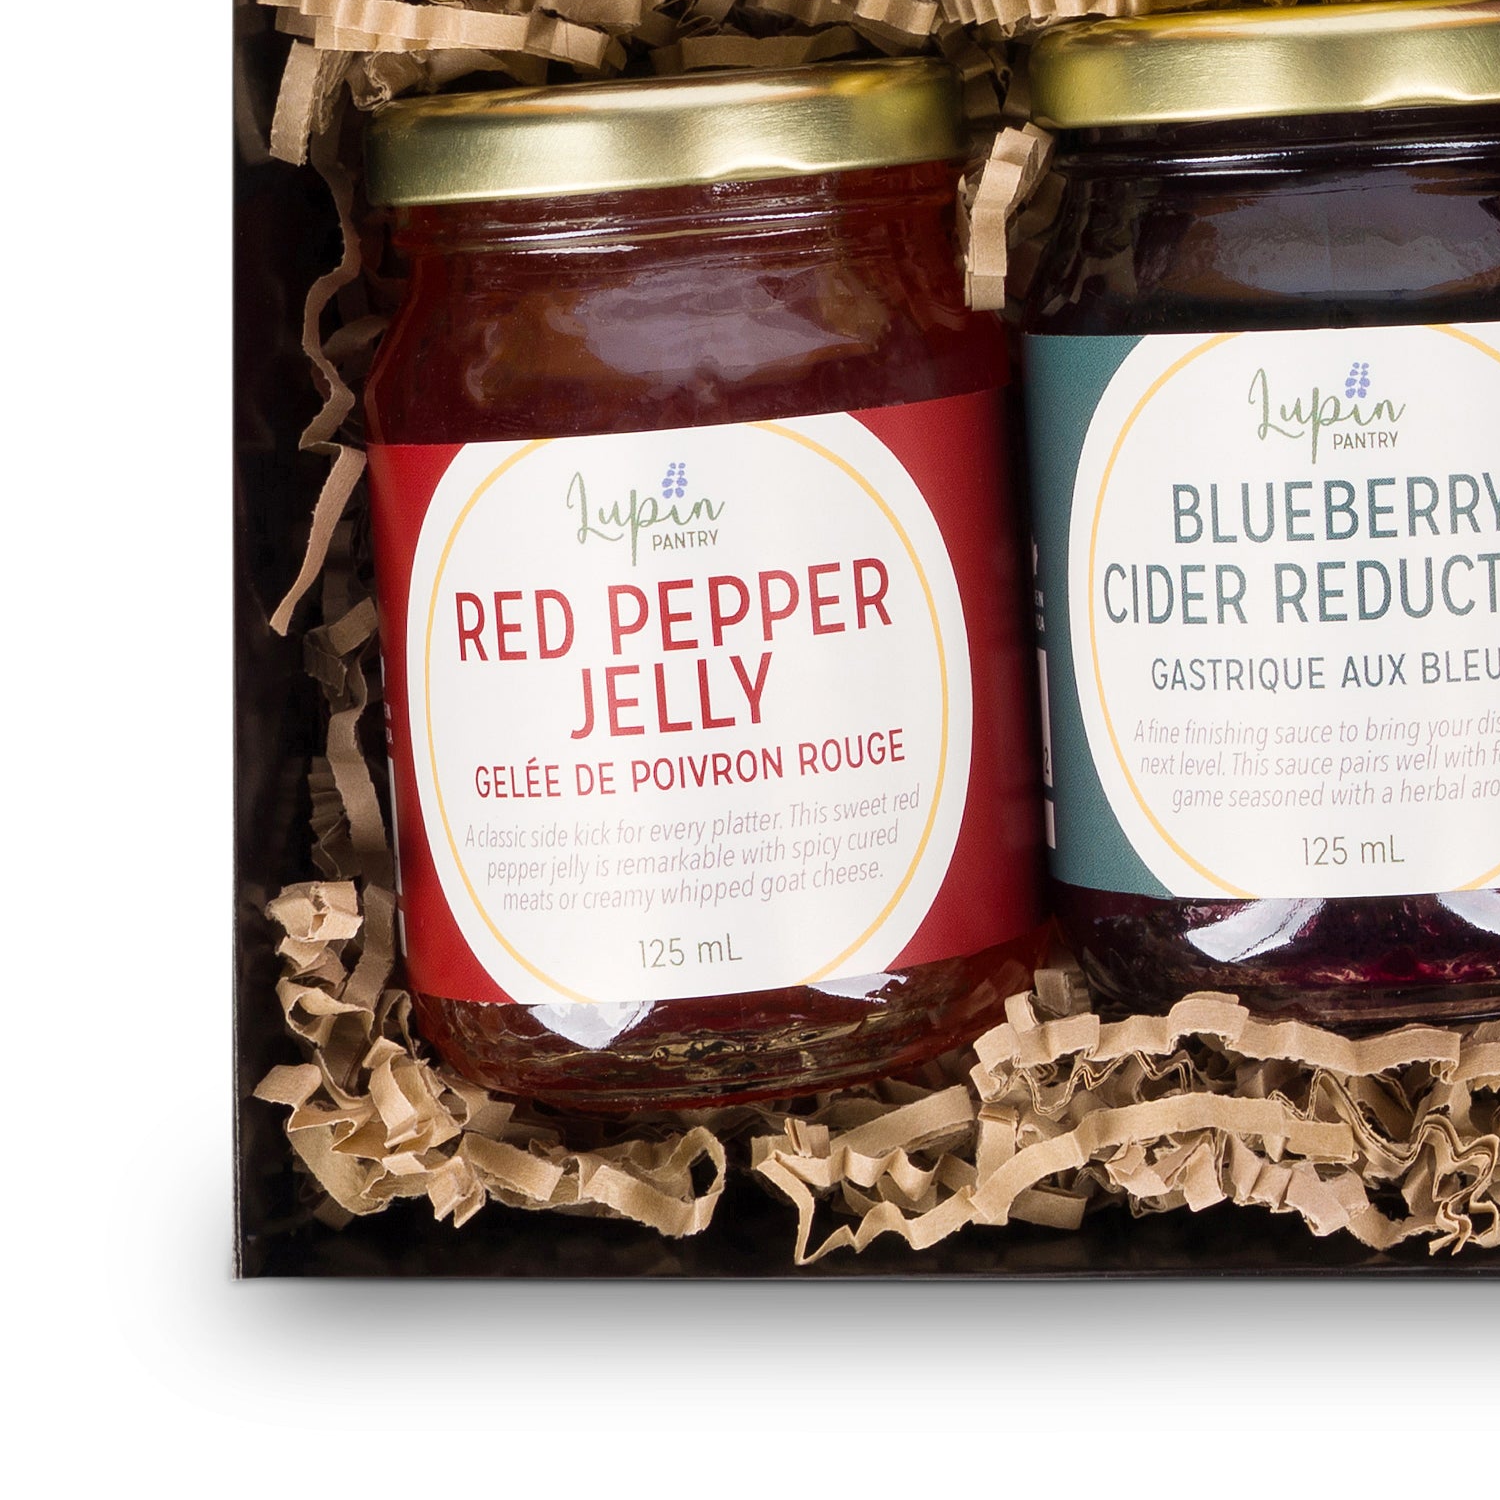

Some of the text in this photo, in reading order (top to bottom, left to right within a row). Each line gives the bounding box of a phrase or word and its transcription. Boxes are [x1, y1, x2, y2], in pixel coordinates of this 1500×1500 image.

[1248, 367, 1406, 464] Lupin
[1334, 431, 1398, 449] PANTRY
[567, 470, 725, 566] Lupin
[653, 529, 718, 551] PANTRY
[456, 558, 892, 661] RED PEPPER
[1104, 563, 1248, 624] CIDER
[571, 652, 772, 739] JELLY
[1152, 657, 1325, 694] GASTRIQUE
[1341, 653, 1406, 688] AUX
[1134, 720, 1144, 742] A
[1149, 718, 1179, 743] fine
[1185, 719, 1268, 751] finishing
[1274, 725, 1332, 744] sauce
[1339, 721, 1358, 742] to
[1366, 717, 1420, 746] bring
[1426, 714, 1471, 744] your
[476, 728, 905, 798] GELÉE DE POIVRON ROUGE
[1141, 755, 1175, 775] next
[1180, 751, 1225, 776] level.
[1232, 751, 1269, 776] This
[1275, 757, 1333, 775] sauce
[1339, 750, 1389, 781] pairs
[1397, 745, 1438, 771] well
[1445, 742, 1485, 768] with
[465, 783, 920, 848] A classic side kick for every platter. This sweet red
[1173, 789, 1223, 813] game
[1228, 781, 1325, 807] seasoned
[1332, 780, 1374, 805] with
[1382, 787, 1392, 803] a
[1400, 774, 1465, 803] herbal
[488, 818, 898, 886] pepper jelly is remarkable with spicy cured
[1303, 835, 1404, 865] 125 mL
[504, 861, 883, 913] meats or creamy whipped goat cheese.
[639, 933, 742, 968] 125 mL
